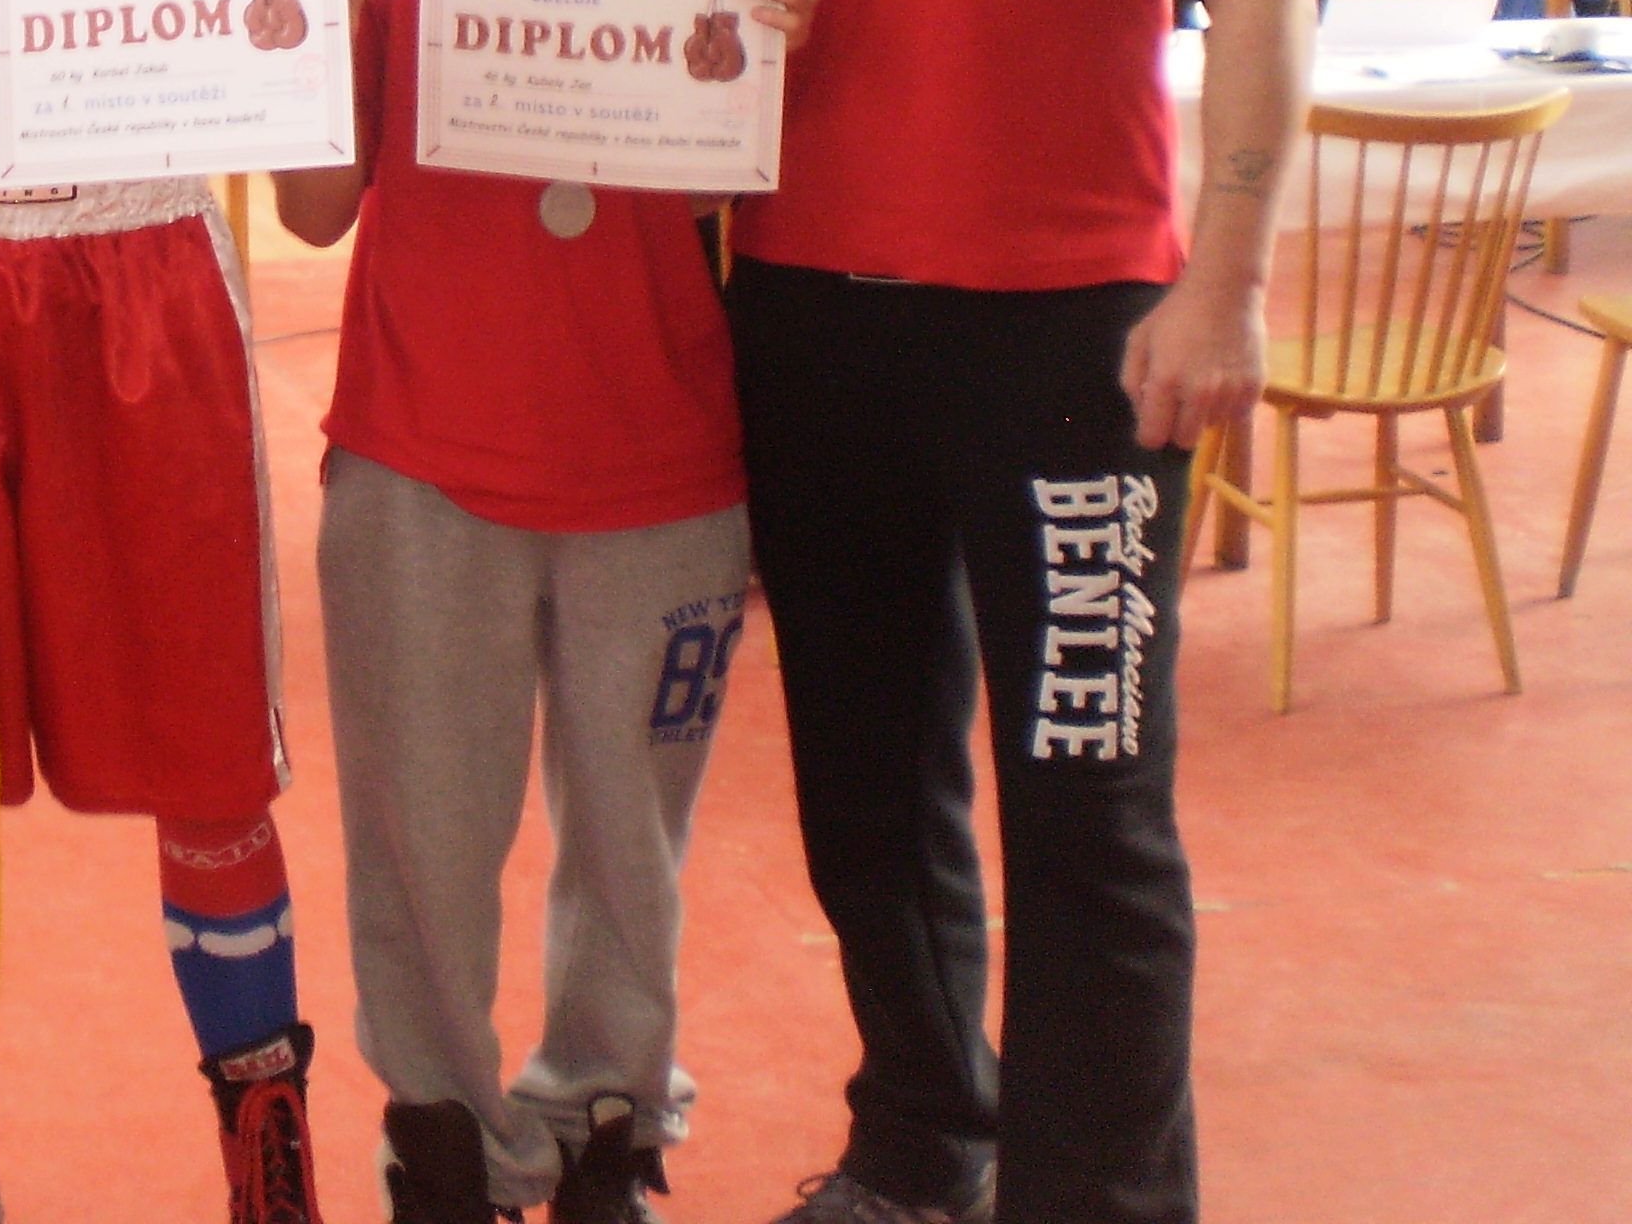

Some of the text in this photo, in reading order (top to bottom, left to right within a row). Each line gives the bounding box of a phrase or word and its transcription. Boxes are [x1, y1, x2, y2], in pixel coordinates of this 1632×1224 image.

[454, 12, 674, 65] DIPLOM
[463, 95, 482, 109] za
[573, 107, 583, 117] v
[1032, 474, 1121, 761] BENLEE
